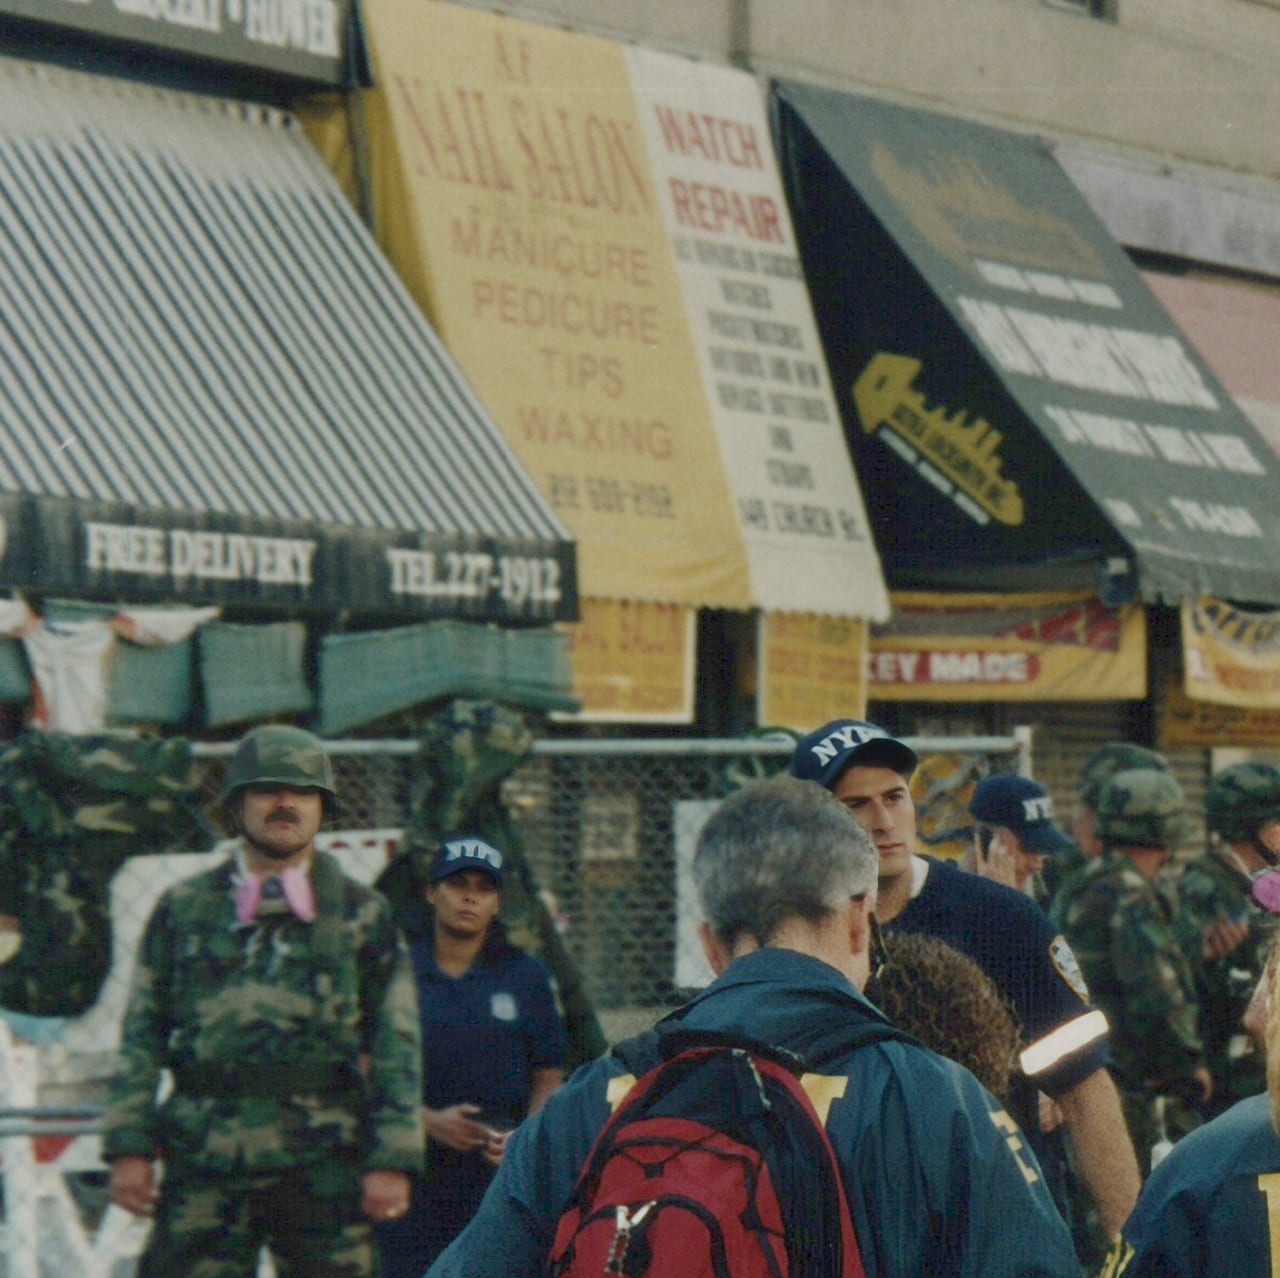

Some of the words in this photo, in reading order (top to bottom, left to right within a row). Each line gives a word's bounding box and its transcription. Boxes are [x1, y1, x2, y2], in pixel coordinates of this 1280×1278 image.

[393, 72, 514, 192] NAIL
[509, 95, 650, 215] SALON
[653, 103, 765, 171] WATCH
[667, 176, 785, 246] REPAIR
[451, 216, 653, 288] MANICURE
[471, 281, 662, 346] PEDICURE
[539, 346, 625, 399] TIPS
[516, 404, 673, 461] WAXING
[86, 522, 166, 576] FREE
[170, 529, 316, 585] DELIVERY
[929, 651, 1029, 682] MADE
